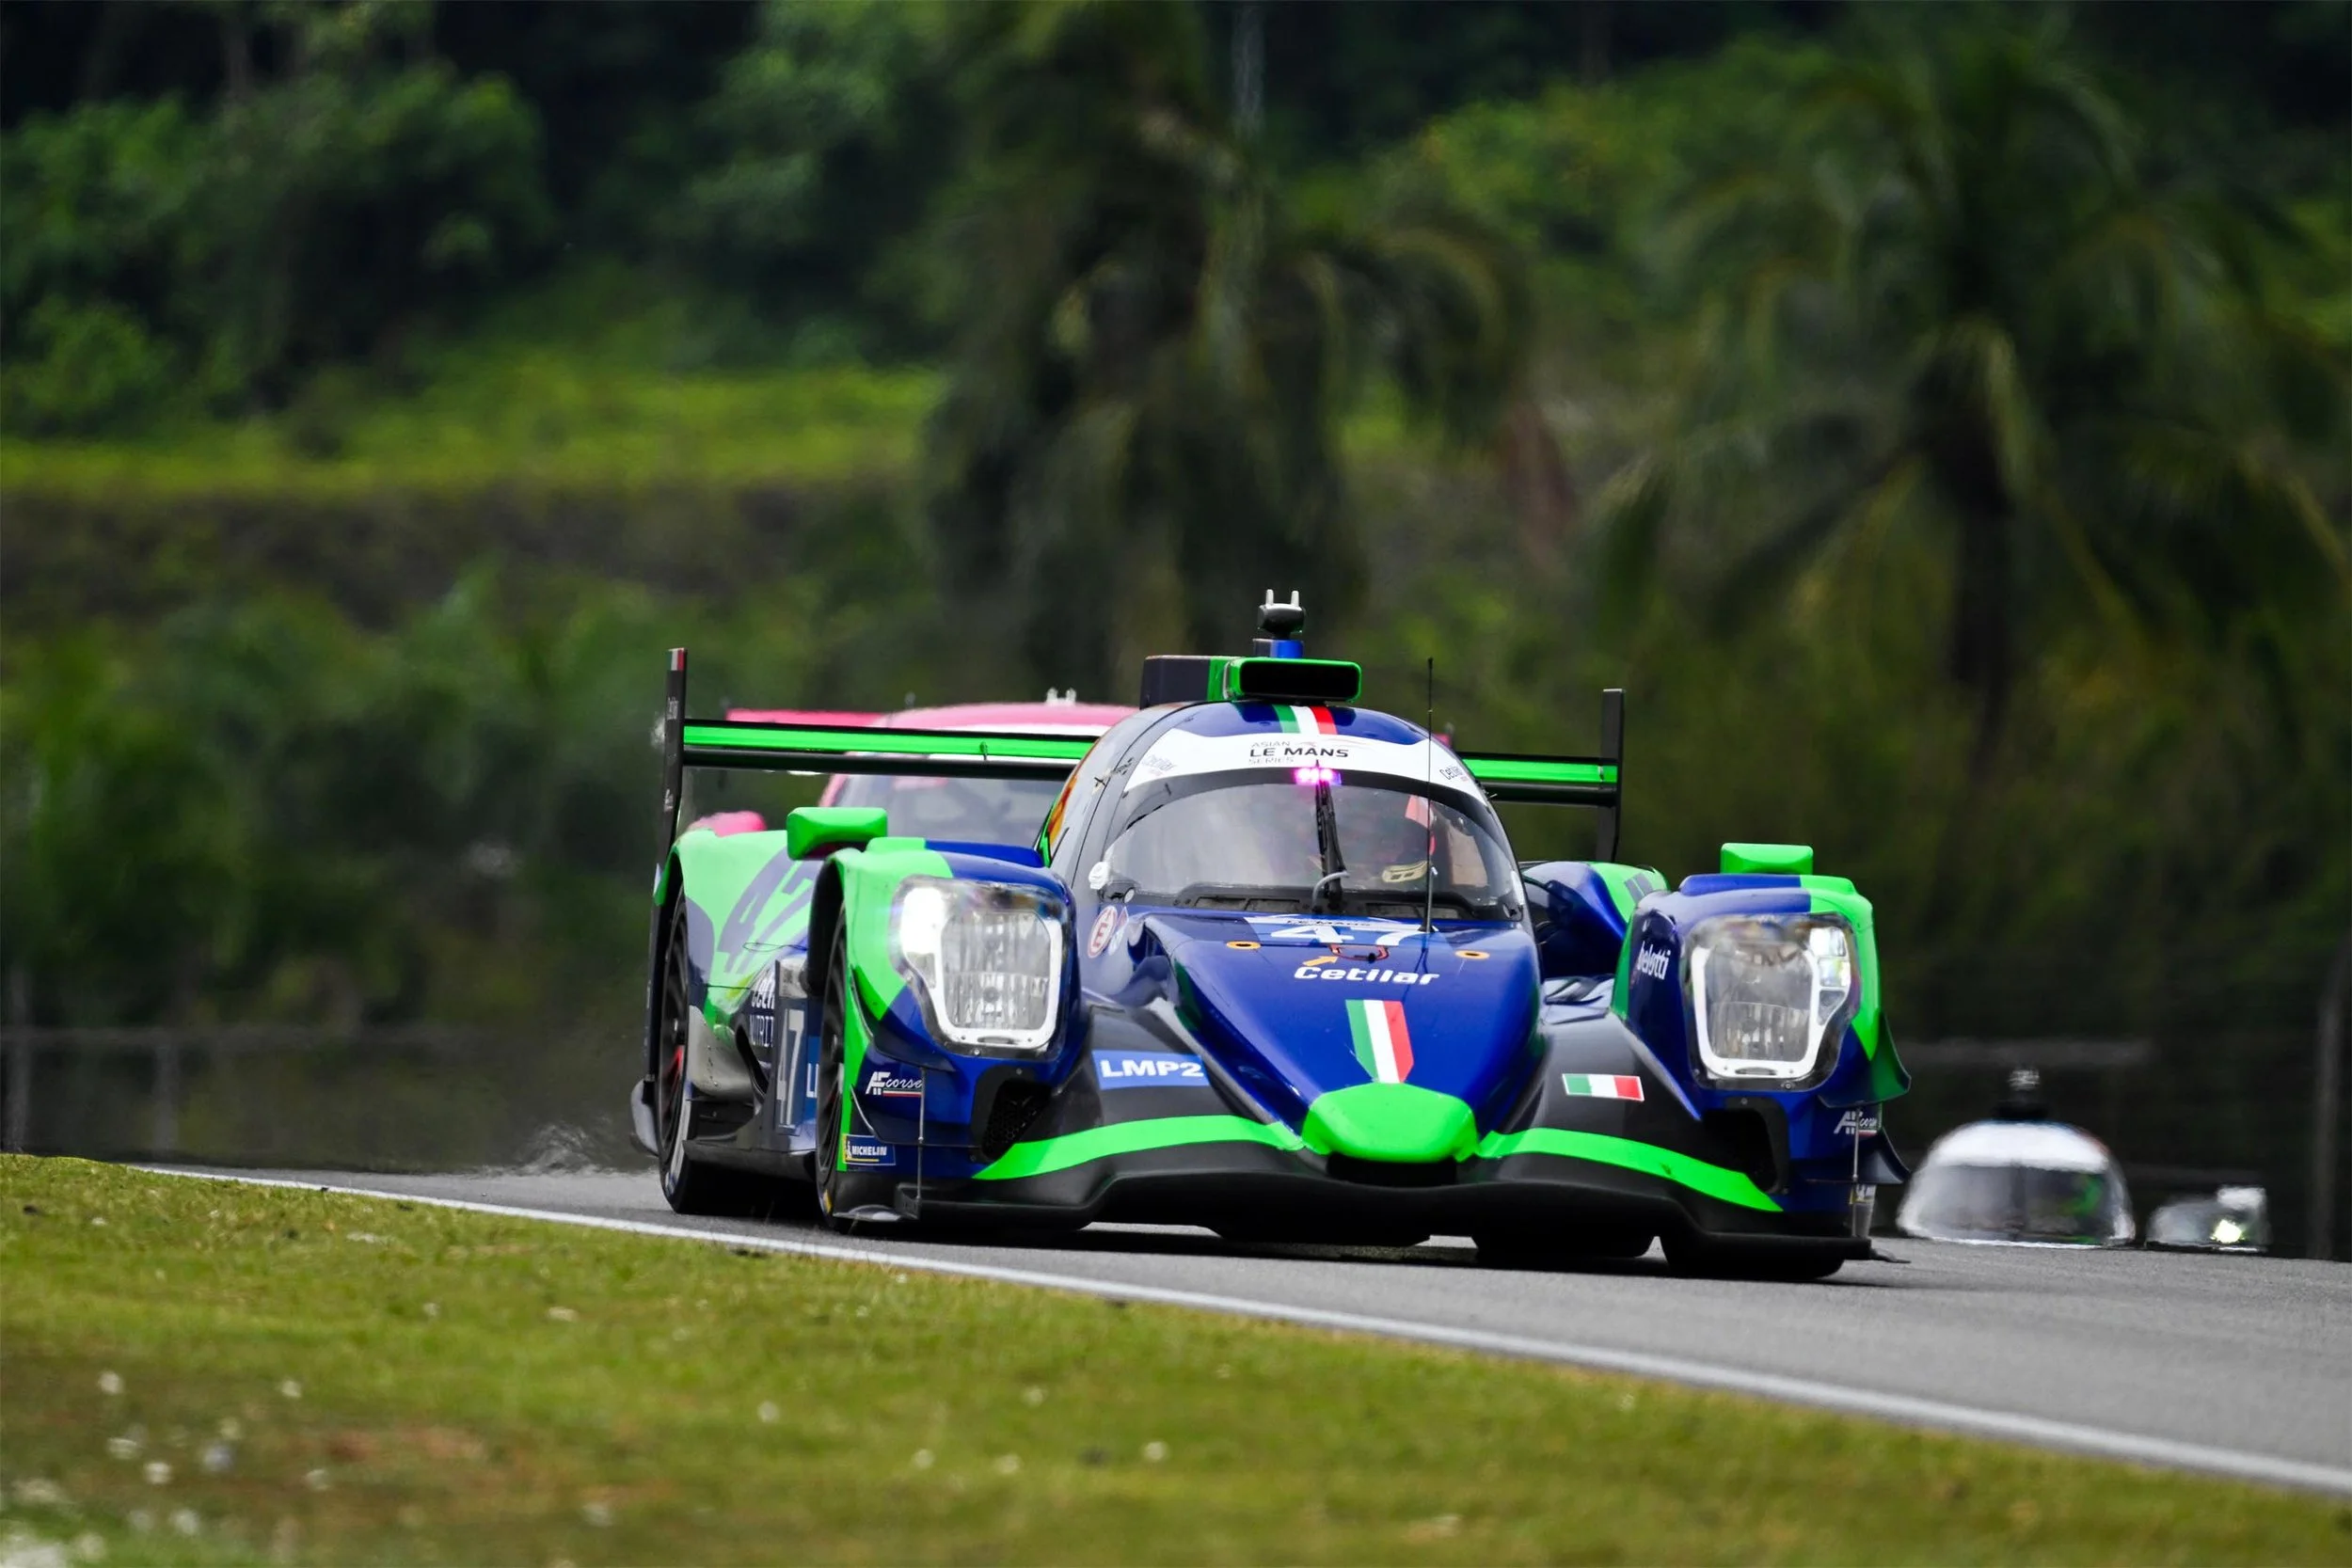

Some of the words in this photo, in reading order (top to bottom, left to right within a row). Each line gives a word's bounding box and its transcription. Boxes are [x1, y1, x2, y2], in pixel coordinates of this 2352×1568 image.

[1249, 747, 1277, 758] LE
[1283, 748, 1349, 758] MANS
[1294, 966, 1440, 985] Cetilar
[1099, 1059, 1204, 1078] LMP2
[851, 1146, 887, 1156] MICHELIN
